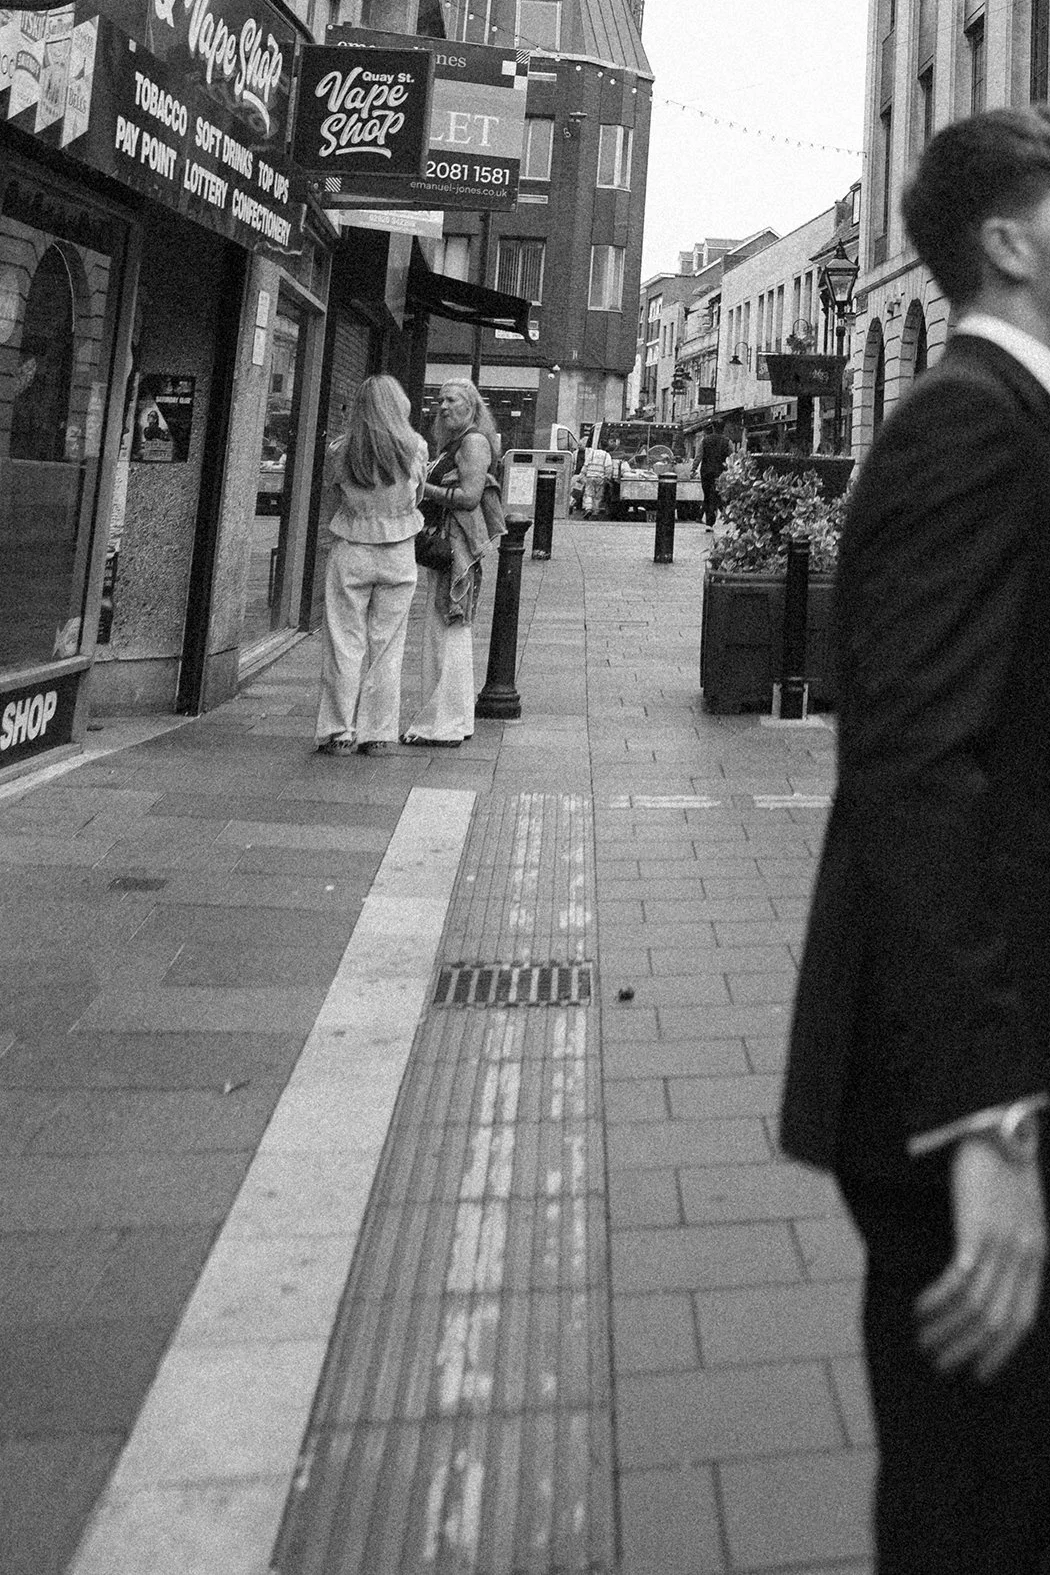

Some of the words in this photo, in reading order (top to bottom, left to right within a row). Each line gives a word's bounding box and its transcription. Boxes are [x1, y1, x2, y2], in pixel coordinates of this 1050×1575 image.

[234, 18, 283, 104] Shop
[362, 71, 394, 84] Quay
[397, 72, 415, 84] St.
[314, 66, 408, 119] Vape
[135, 71, 187, 136] TOBACCO
[195, 116, 222, 158] SOFT
[222, 134, 253, 179] DRINKS
[258, 160, 273, 192] TOP
[273, 172, 290, 204] UPS
[115, 115, 140, 157] PAY
[140, 131, 177, 180] POINT
[183, 159, 228, 208] LOTTERY
[232, 188, 291, 246] CONFECTIONERY
[410, 181, 507, 198] emanuel-jones.co.uk
[426, 160, 468, 181] 2081
[473, 165, 510, 185] 1581
[0, 690, 58, 751] SHOP
